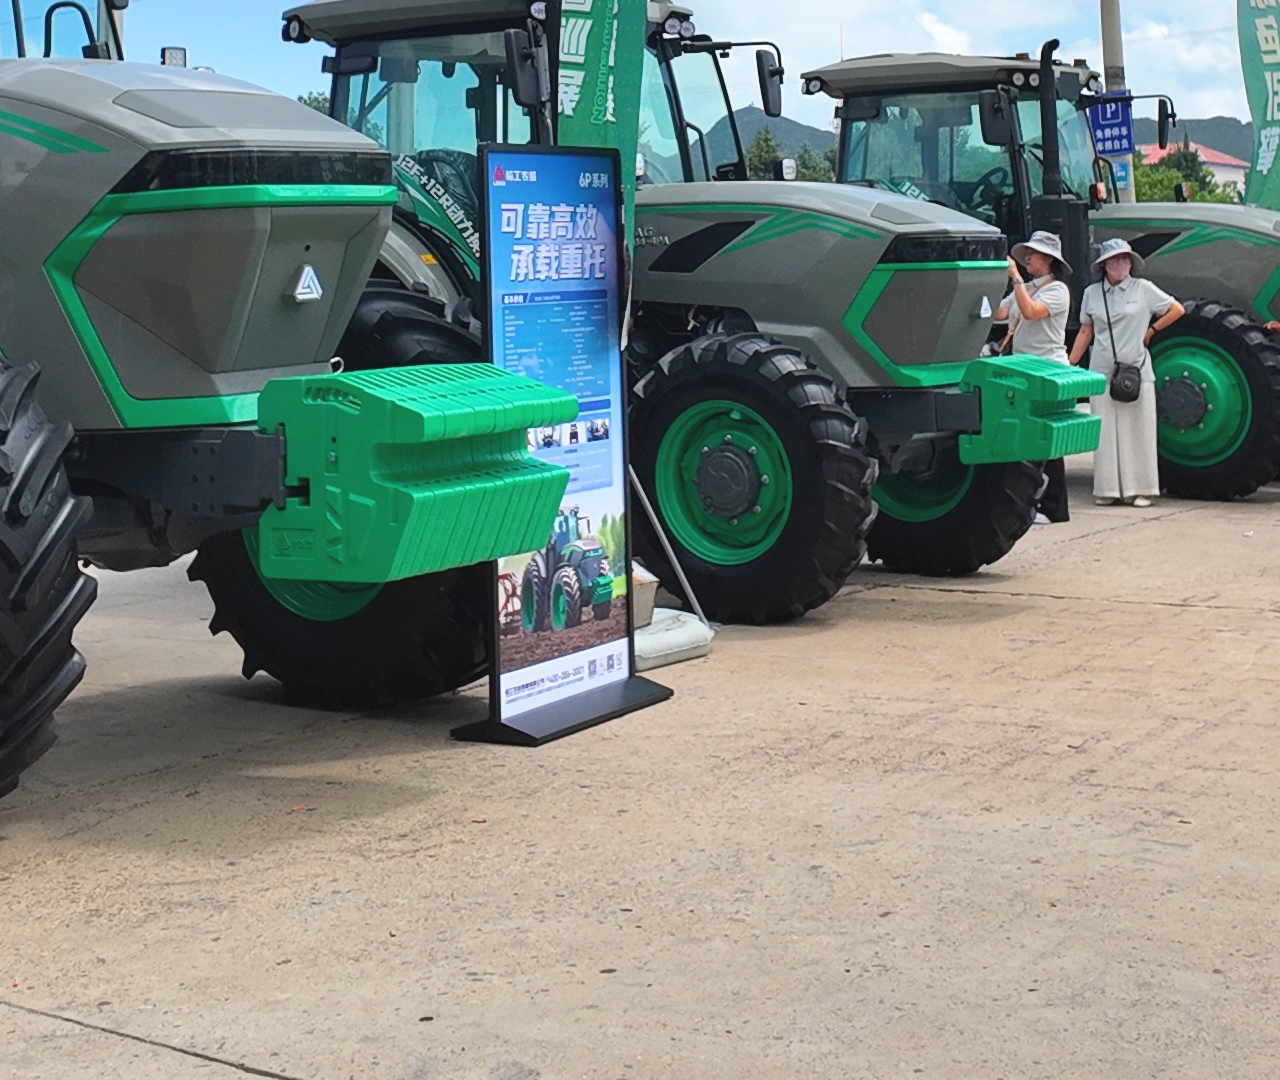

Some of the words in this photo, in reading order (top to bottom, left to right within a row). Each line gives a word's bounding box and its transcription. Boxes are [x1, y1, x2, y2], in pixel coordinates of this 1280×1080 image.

[396, 153, 481, 258] 12F+12R动力换
[500, 203, 598, 240] 可靠高效
[510, 242, 606, 281] 承载重托
